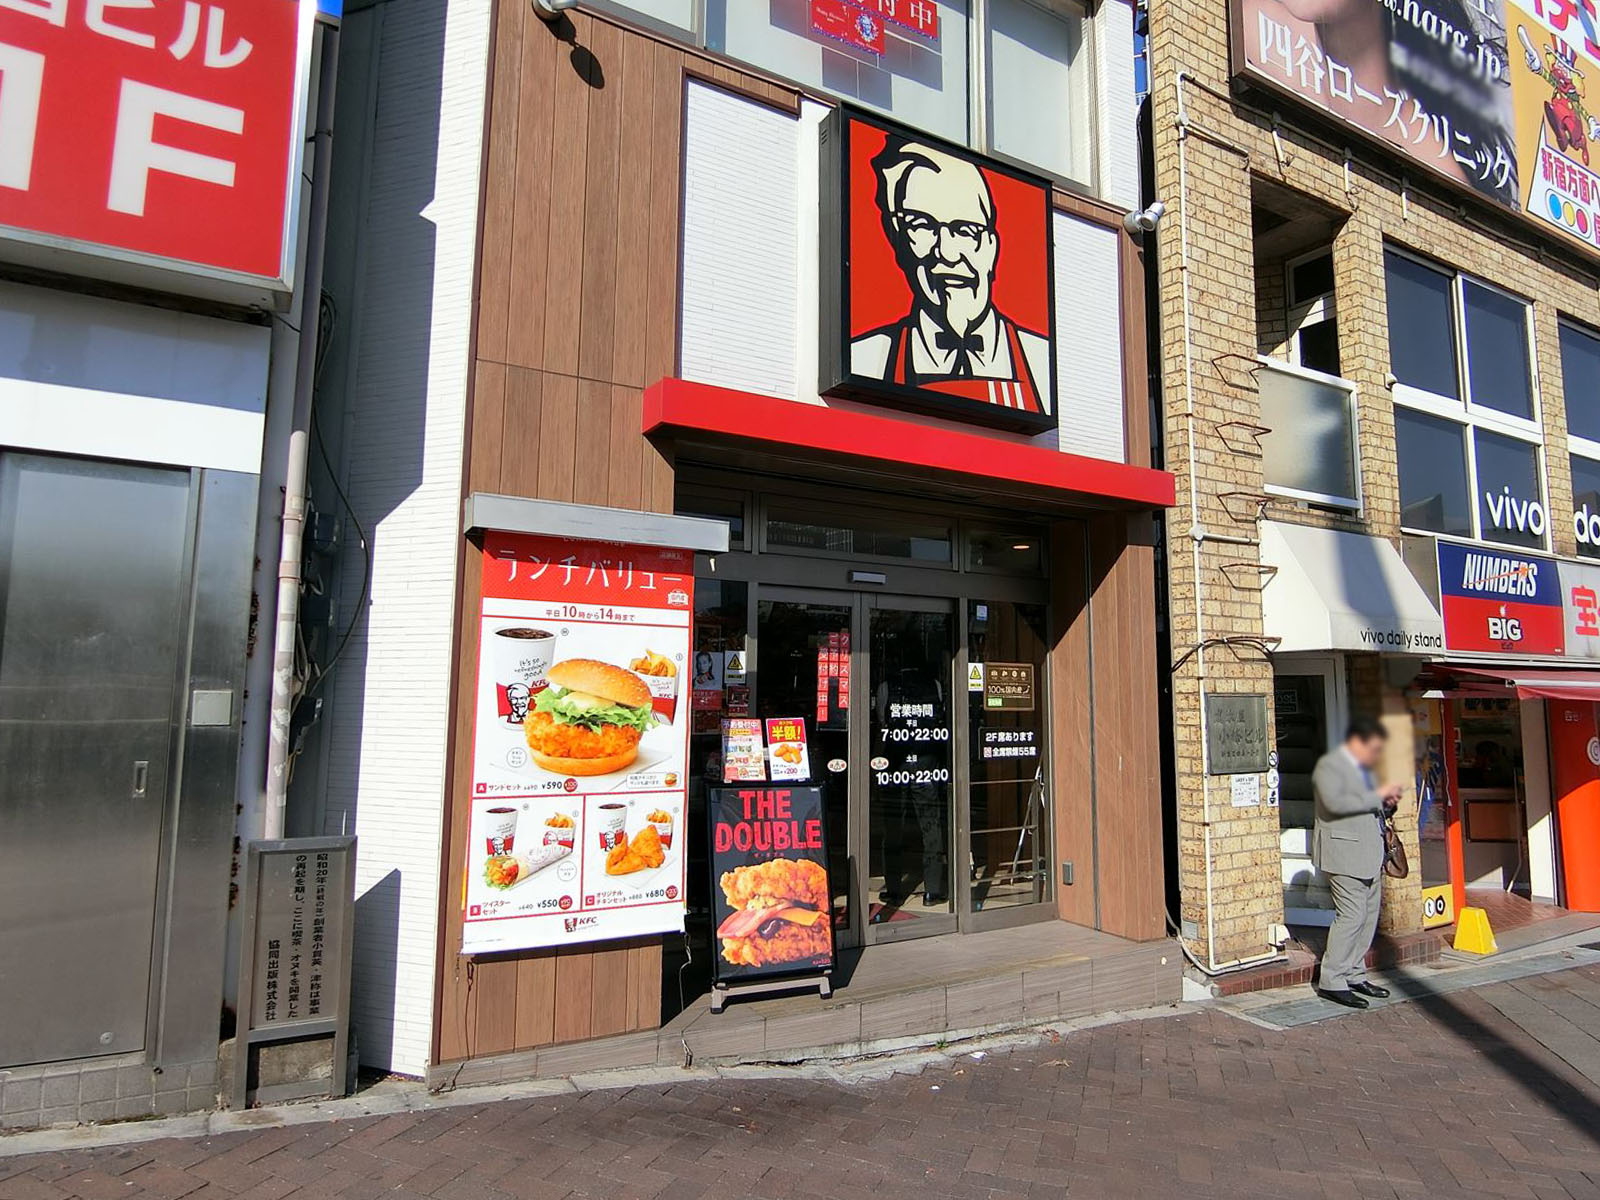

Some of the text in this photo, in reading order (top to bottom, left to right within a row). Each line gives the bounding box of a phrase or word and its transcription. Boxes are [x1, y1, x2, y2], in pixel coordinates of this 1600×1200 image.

[0, 0, 253, 68] ビル
[1258, 10, 1512, 189] 四谷ローズクリニック
[1486, 486, 1545, 536] vivo
[497, 550, 682, 590] ランチバリュー
[1463, 553, 1538, 597] NUMBERS
[1360, 628, 1442, 649] vivo daily stand
[1488, 617, 1522, 641] BIG
[890, 704, 934, 718] 営業時間
[772, 725, 801, 741] 半額!
[881, 727, 949, 742] 7:00 22:00
[985, 731, 1034, 742] 2F席あります
[906, 754, 918, 762] 土日
[541, 781, 563, 790] ¥590
[876, 768, 949, 785] 10:00 22:00
[739, 790, 792, 820] THE
[715, 820, 822, 852] DOUBLE
[645, 889, 665, 898] ¥680
[537, 898, 558, 909] ¥550
[579, 916, 598, 925] KFC
[265, 939, 281, 1021] 協同出版株式会社
